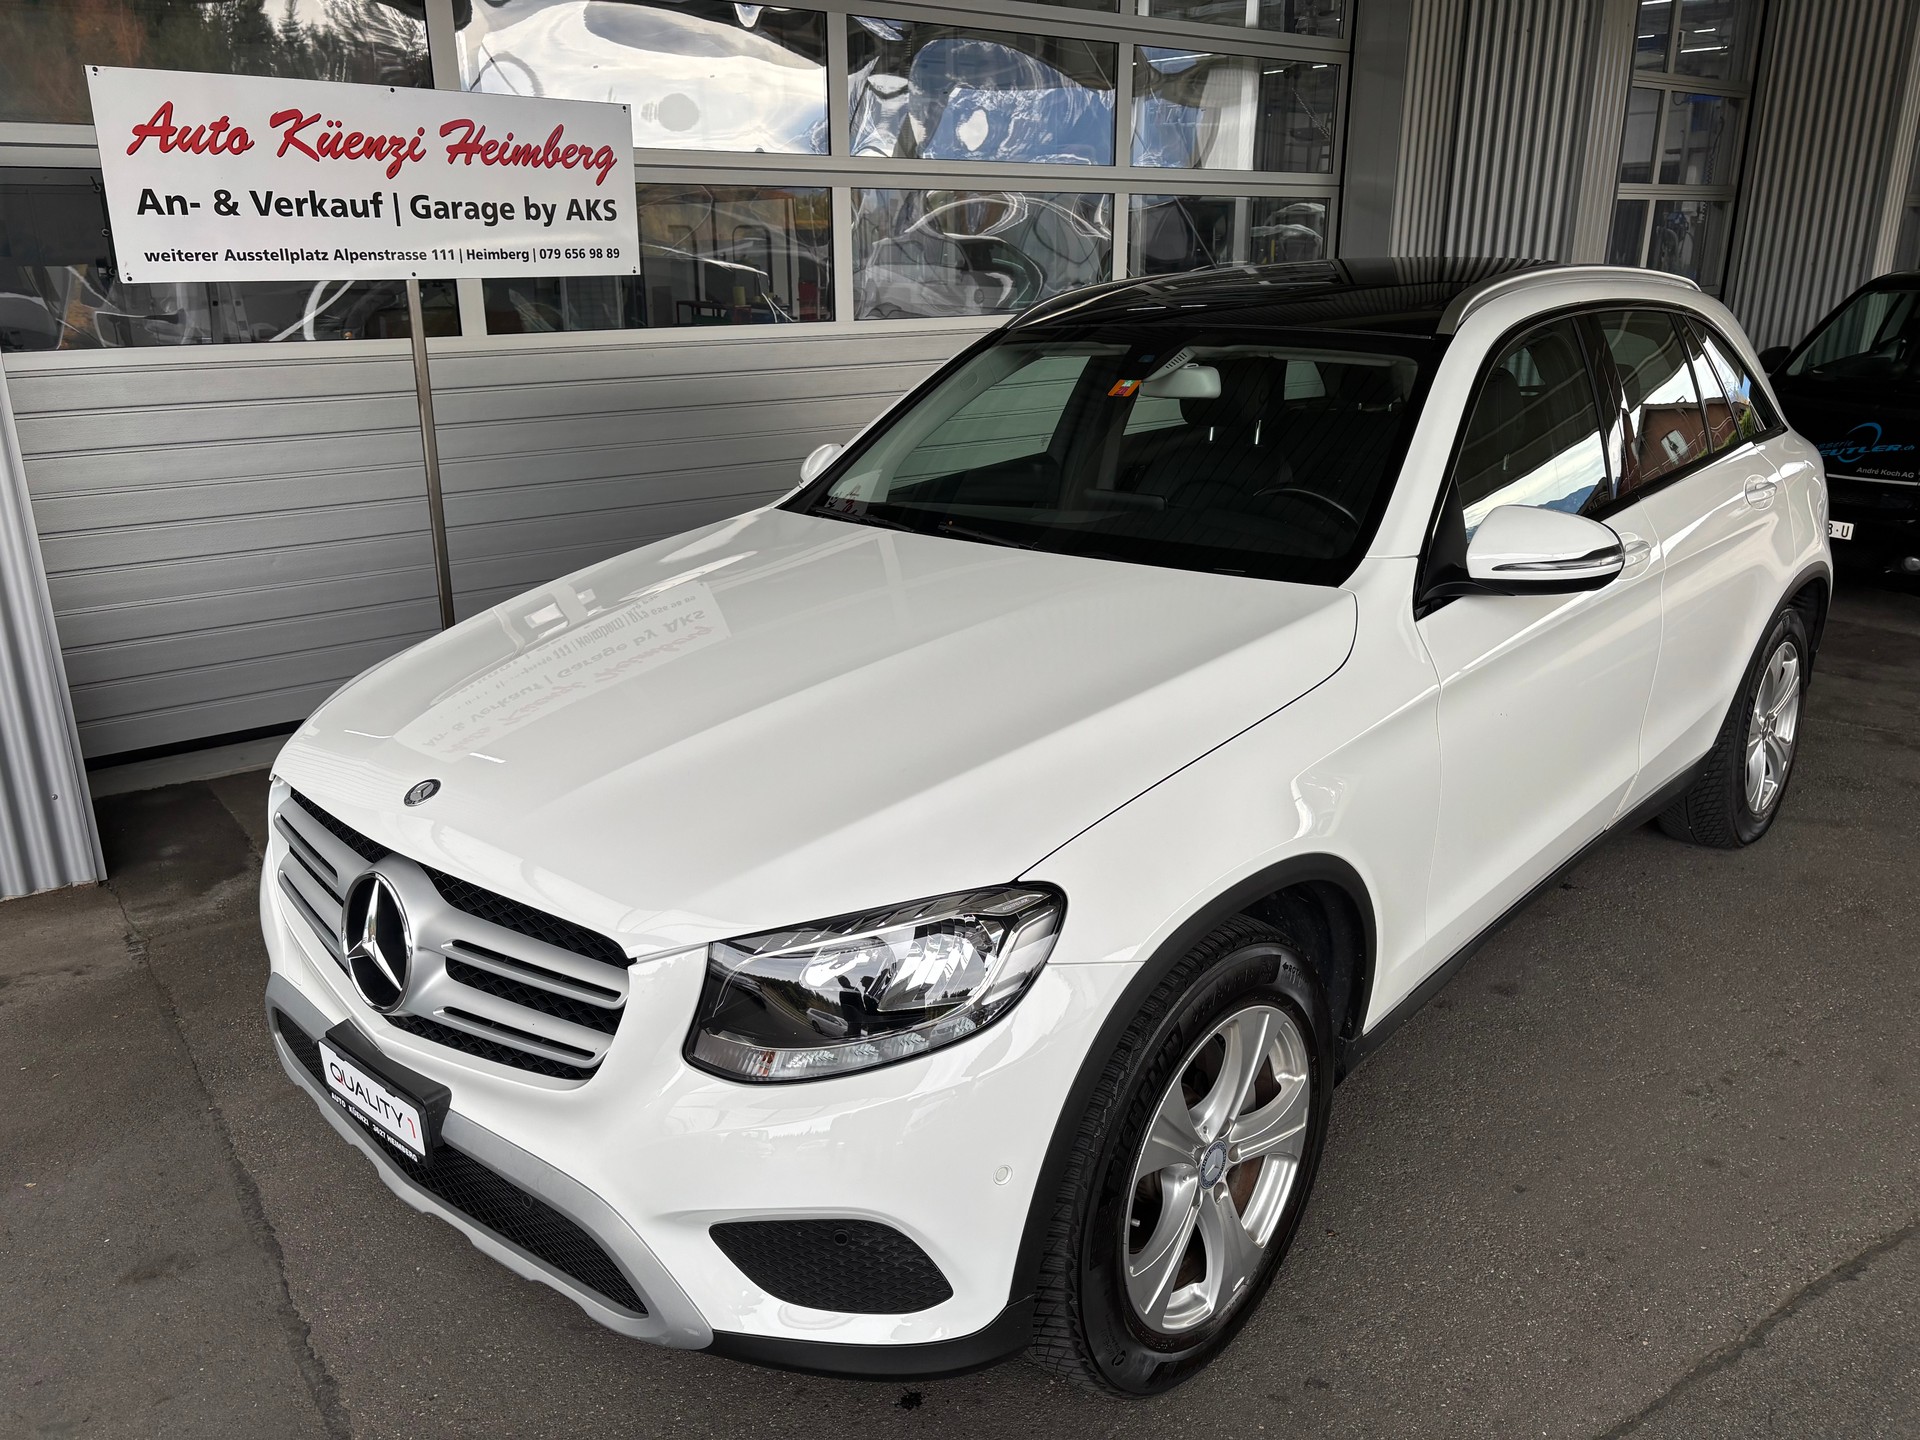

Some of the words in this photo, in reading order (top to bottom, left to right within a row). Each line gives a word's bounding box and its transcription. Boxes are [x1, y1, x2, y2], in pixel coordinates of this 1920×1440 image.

[126, 100, 255, 156] Auto
[269, 108, 426, 180] Küenzi
[439, 118, 617, 186] Heimberg
[136, 188, 201, 216] An-
[213, 189, 241, 217] &
[248, 189, 384, 219] Verkauf
[409, 194, 516, 227] Garage
[523, 195, 557, 228] by
[565, 198, 618, 222] AKS
[143, 248, 219, 262] weiterer
[224, 248, 329, 265] Ausstellplatz
[333, 247, 427, 264] Alpenstrasse
[431, 249, 455, 261] 111
[466, 248, 530, 264] Heimberg
[539, 248, 561, 260] 079
[564, 248, 586, 260] 656
[589, 248, 603, 260] 98
[606, 247, 620, 259] 89
[1856, 467, 1880, 475] André
[1880, 469, 1900, 477] Koch
[330, 1062, 403, 1128] QUALITY
[331, 1092, 346, 1108] AUTO
[386, 1134, 419, 1163] HEIMBERG
